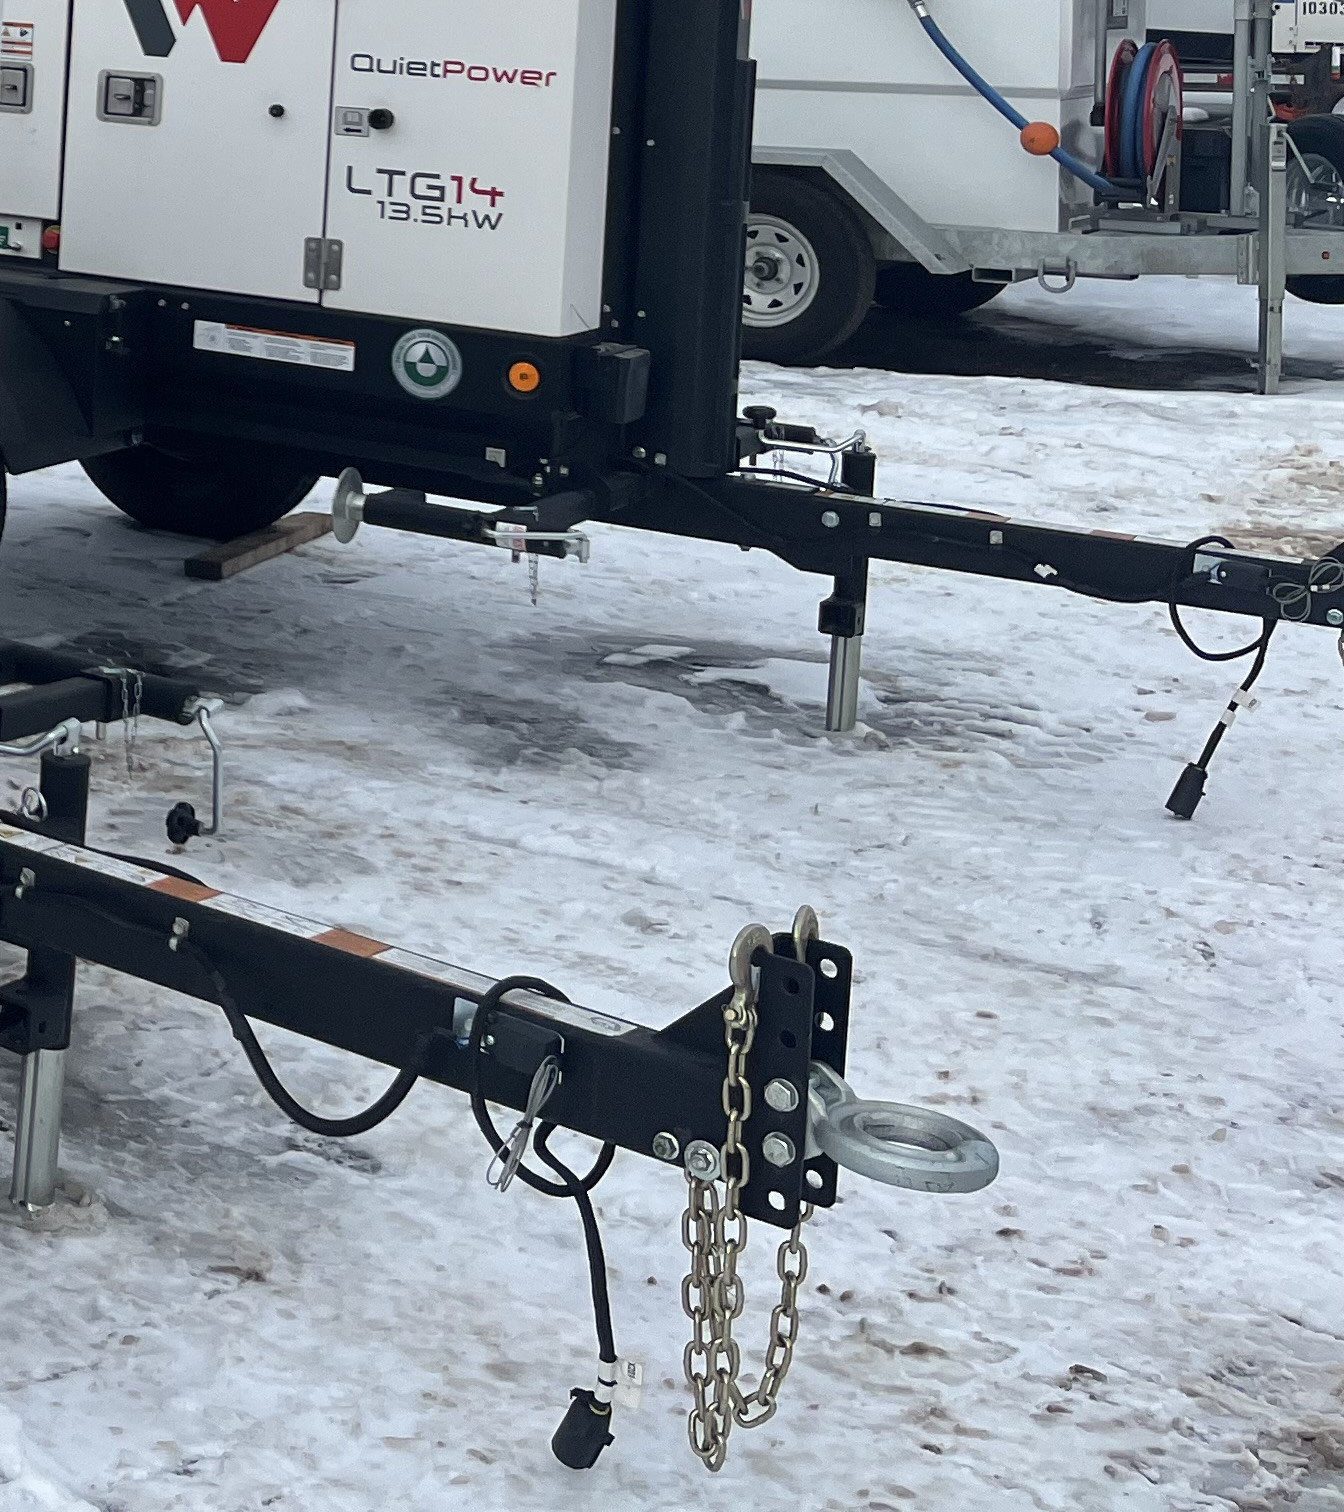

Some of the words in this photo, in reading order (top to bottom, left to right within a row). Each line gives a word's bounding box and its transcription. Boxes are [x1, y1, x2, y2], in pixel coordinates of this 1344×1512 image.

[350, 53, 557, 87] QuietPower
[346, 165, 505, 208] LTG14
[376, 199, 503, 230] 13.5kW
